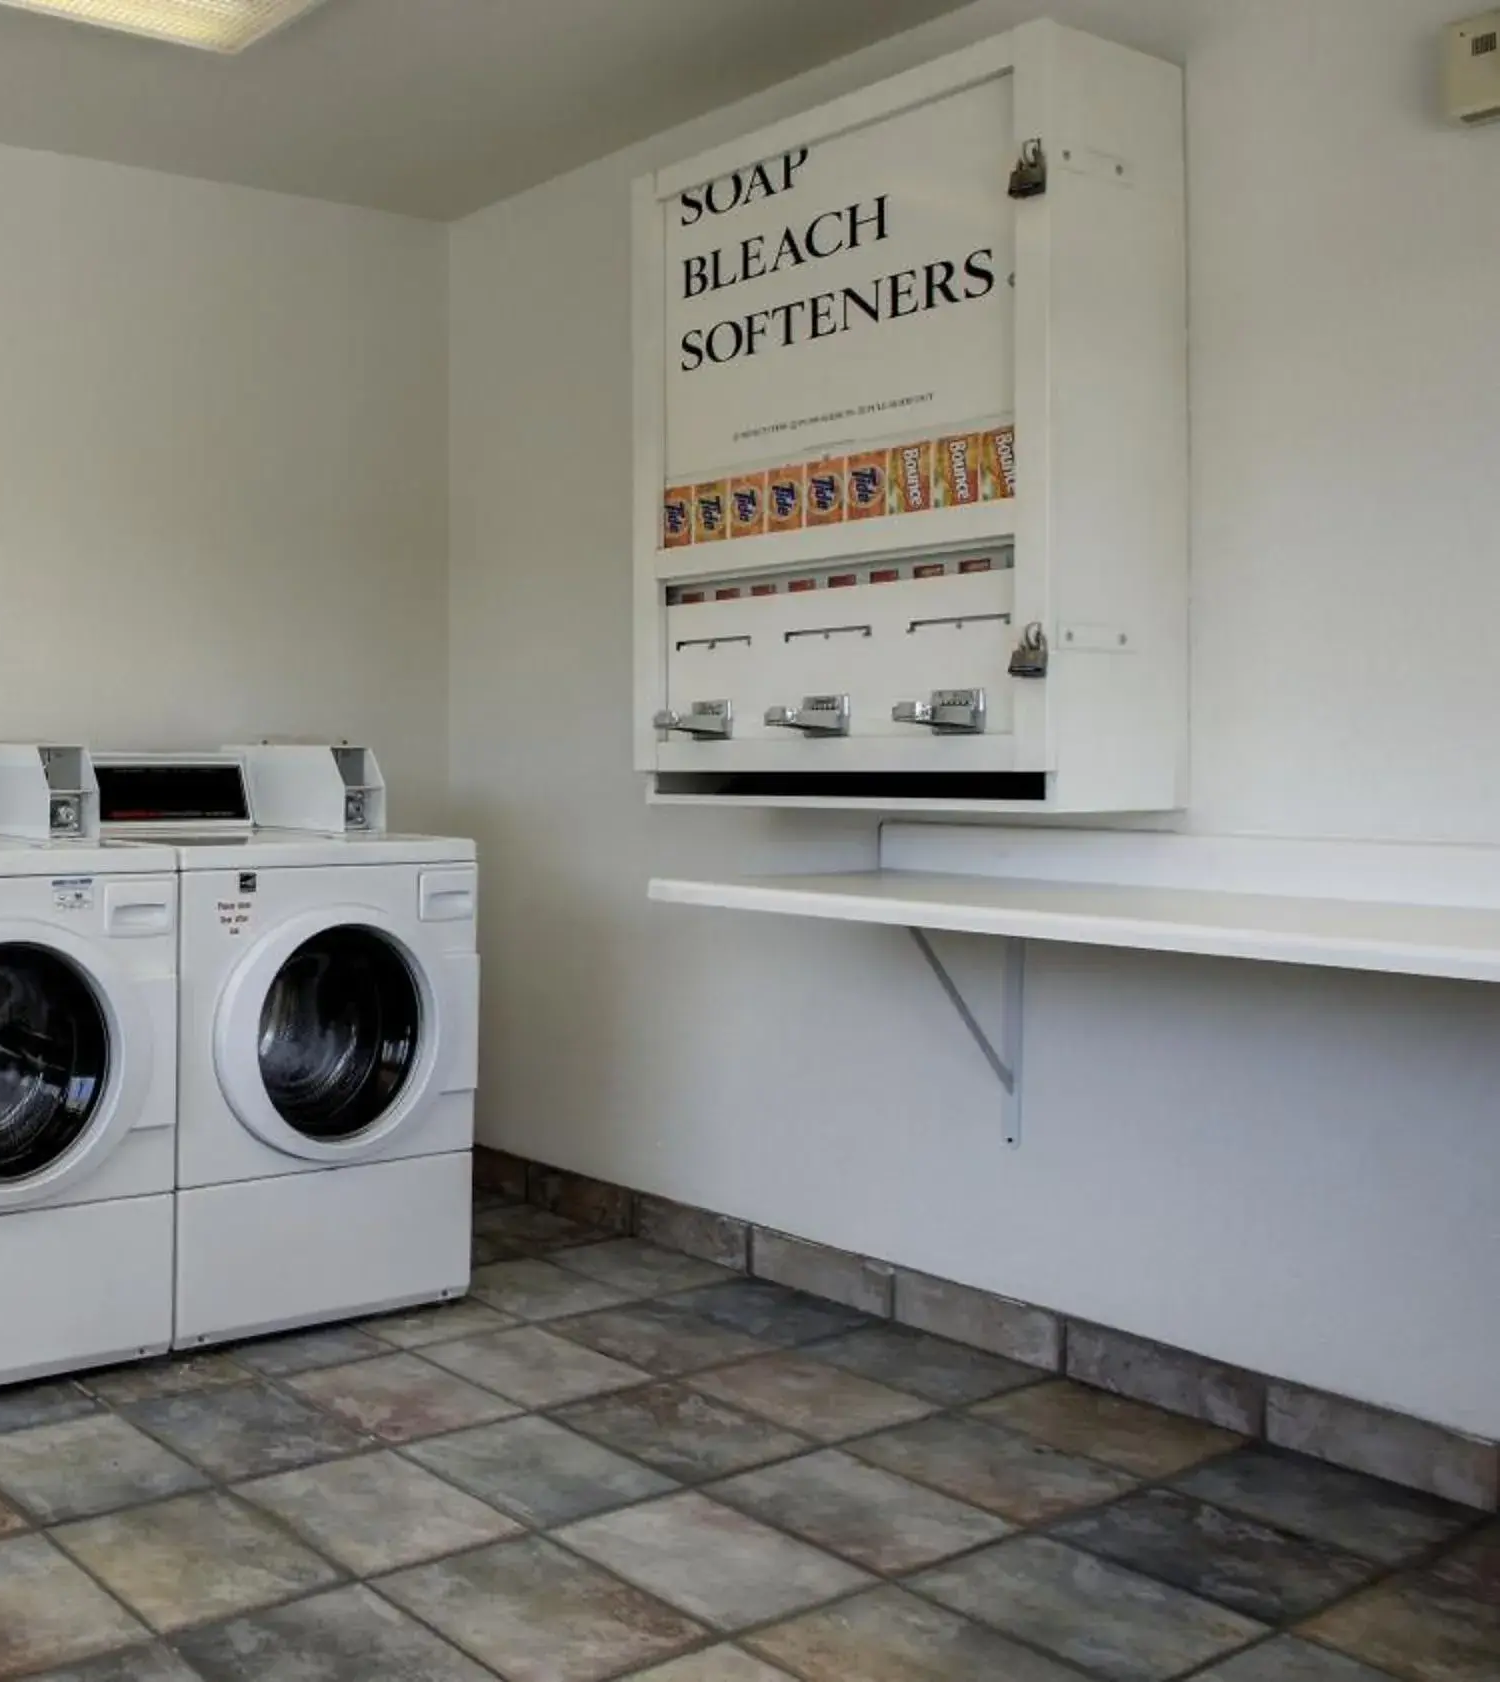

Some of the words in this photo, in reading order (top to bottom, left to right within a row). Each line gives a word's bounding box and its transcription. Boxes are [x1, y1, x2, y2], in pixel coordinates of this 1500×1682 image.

[680, 147, 809, 226] SOAP
[681, 194, 889, 299] BLEACH
[680, 248, 995, 372] SOFTENERS
[851, 467, 877, 502] Tide
[903, 447, 922, 509] Bounce
[950, 440, 970, 500] Bounce
[733, 488, 757, 522] Tide
[771, 481, 796, 516] Tide
[811, 475, 835, 510] Tide
[664, 501, 685, 533] Tide
[698, 495, 722, 530] Tide
